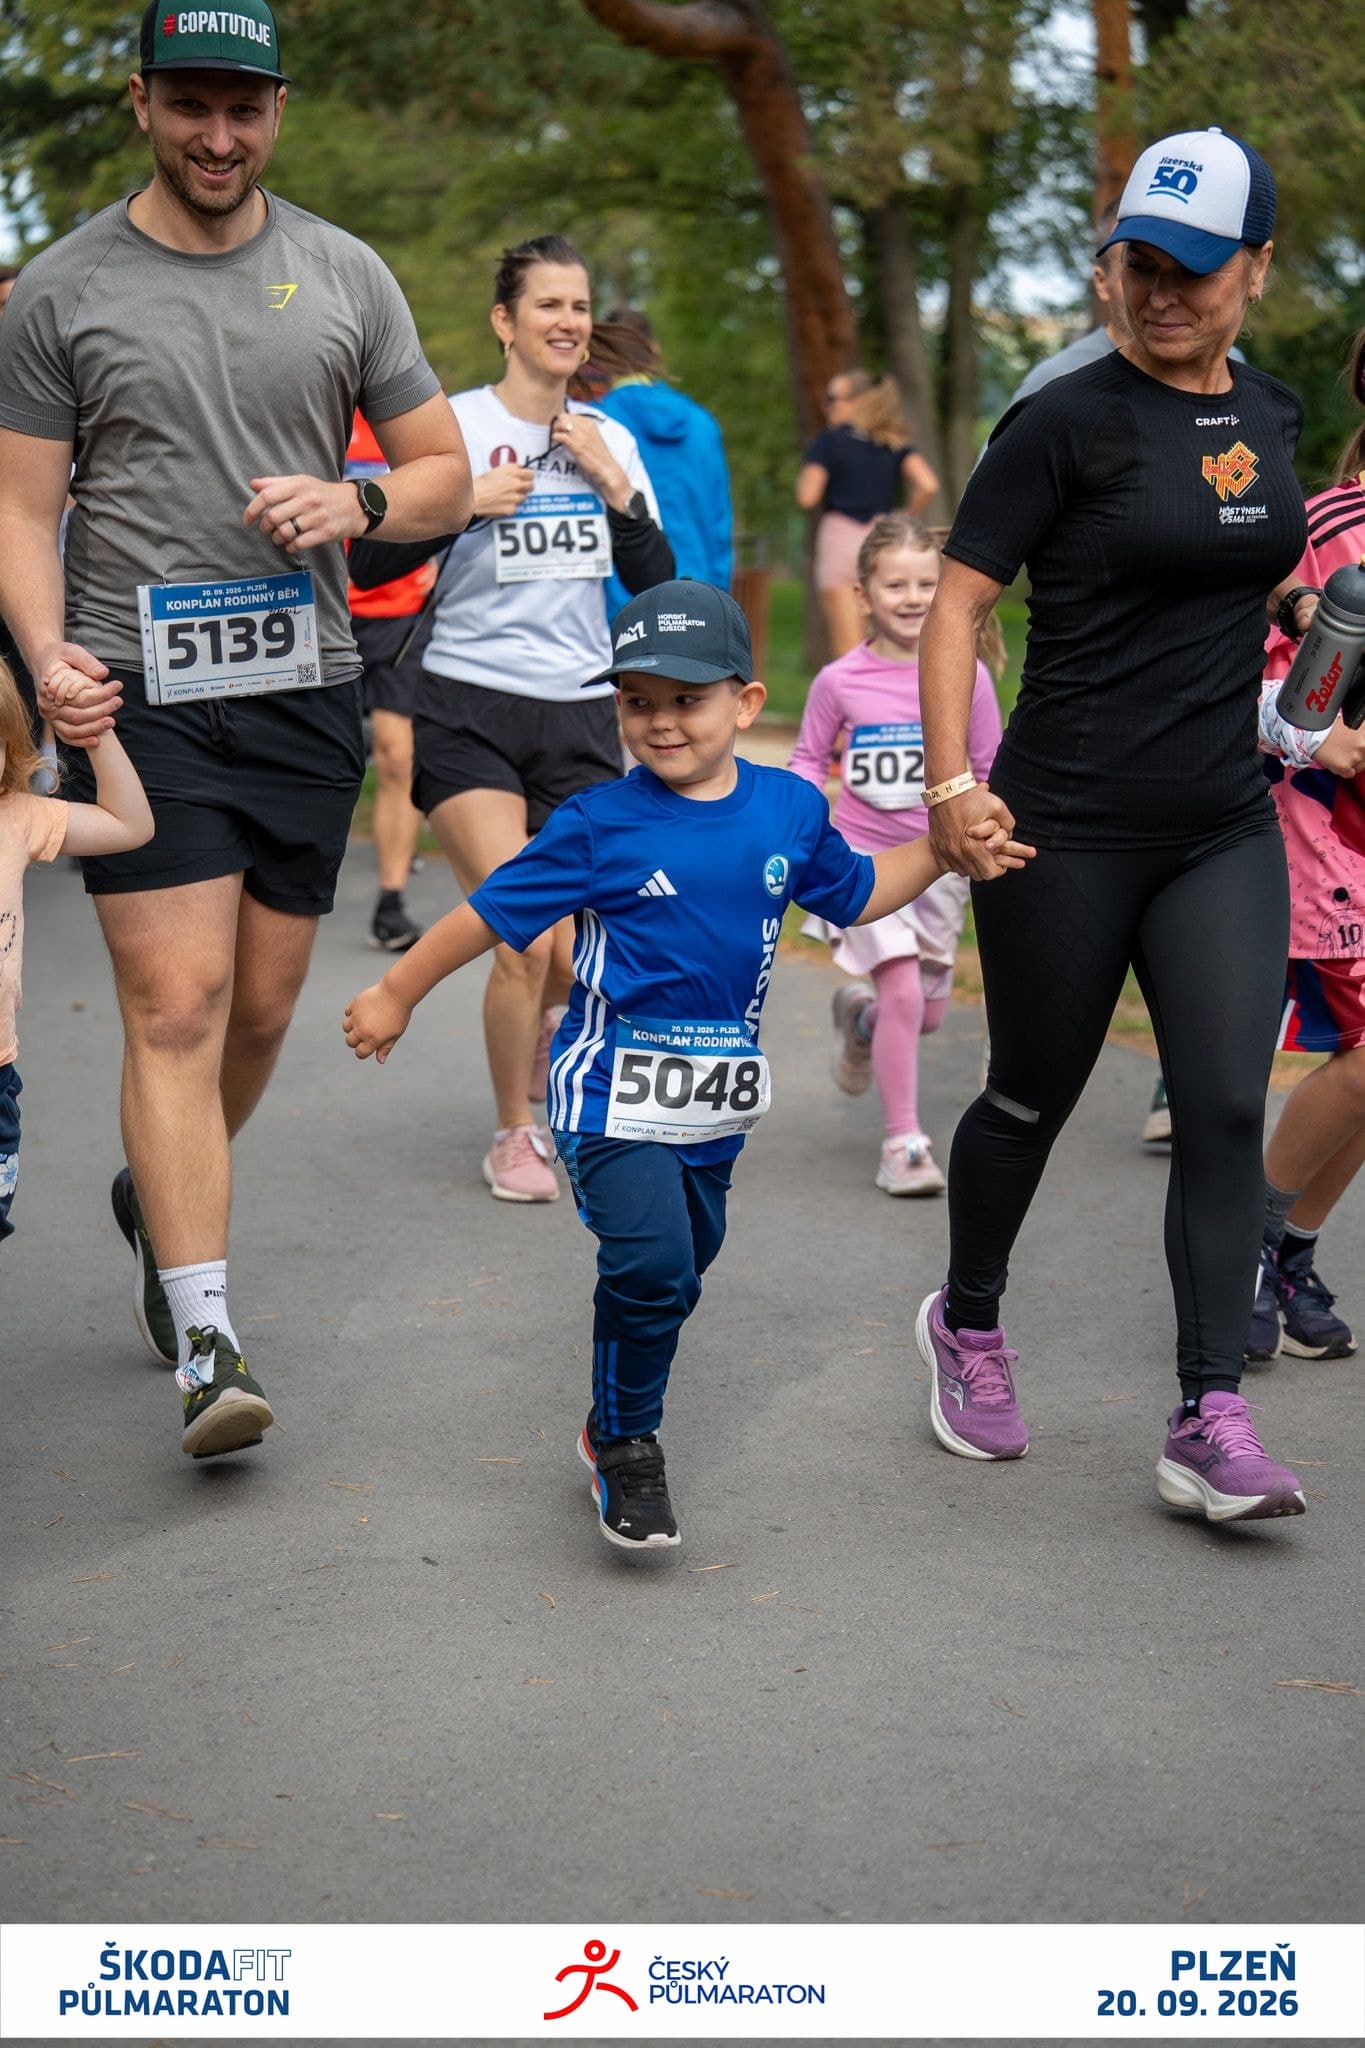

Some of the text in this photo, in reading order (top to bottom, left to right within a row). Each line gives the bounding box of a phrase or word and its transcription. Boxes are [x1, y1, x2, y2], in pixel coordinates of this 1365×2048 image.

[162, 11, 271, 47] #COPATUTOJE
[1149, 166, 1198, 196] 50
[1195, 417, 1230, 426] CRAFT
[498, 519, 599, 557] 5045
[166, 587, 299, 612] KONPLAN RODINNÝ BĚH
[167, 613, 296, 671] 5139
[173, 687, 205, 696] KONPLAN
[850, 749, 924, 787] 502
[1338, 923, 1361, 950] 10
[632, 1029, 690, 1047] KONPLAN
[671, 1025, 683, 1033] 20.
[684, 1025, 696, 1034] 09.
[697, 1026, 715, 1034] 2026
[615, 1053, 761, 1112] 5048
[621, 1125, 656, 1136] KONPLAN
